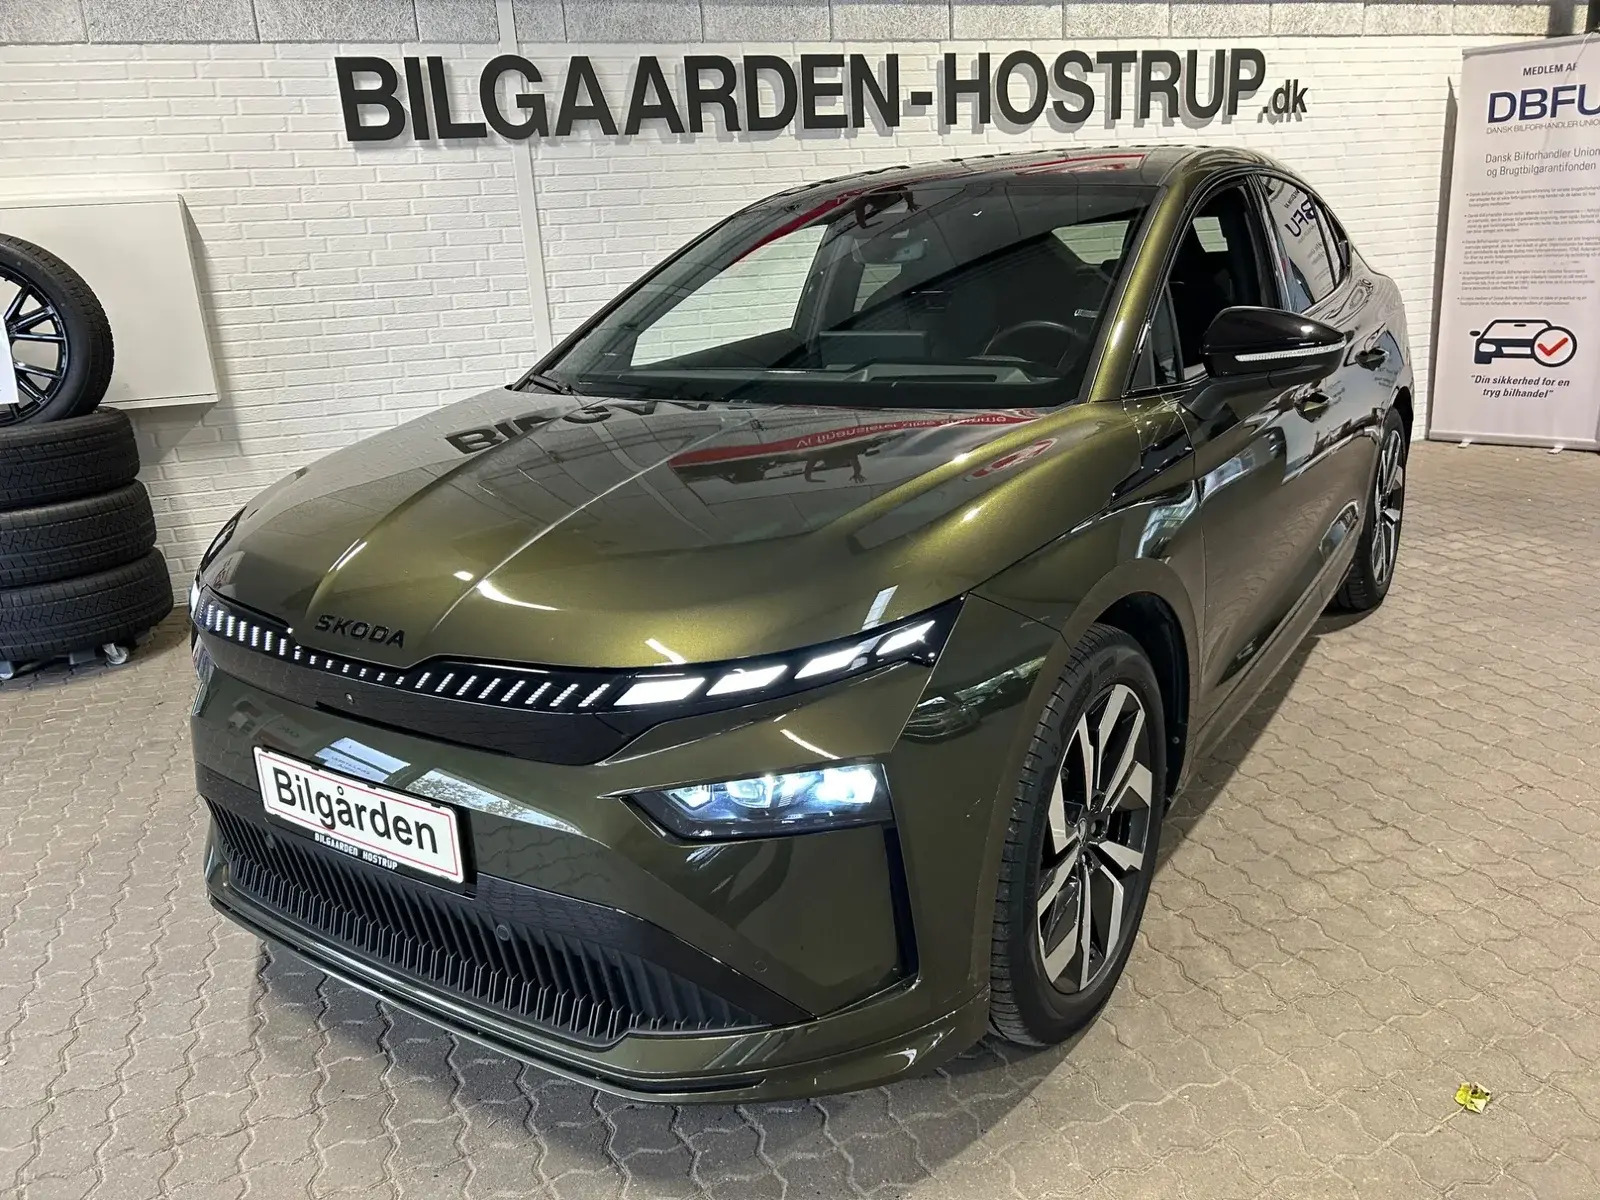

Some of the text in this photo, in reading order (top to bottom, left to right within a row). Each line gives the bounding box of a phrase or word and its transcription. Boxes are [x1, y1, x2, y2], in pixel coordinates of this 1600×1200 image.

[1522, 64, 1564, 76] MEDLEM
[1488, 84, 1600, 123] DBFU
[1486, 125, 1513, 135] DANSK
[1579, 117, 1600, 127] UNIO
[1485, 152, 1512, 164] Dansk
[1514, 148, 1571, 161] Bilforhandler
[1486, 162, 1597, 178] og Brugtbilgarantifonden
[1492, 376, 1540, 387] sikkerhed
[1541, 377, 1555, 387] for
[1482, 388, 1501, 398] tryg
[272, 766, 439, 855] Bilgården
[314, 832, 398, 871] BILGAARDEN HOSTRUP
